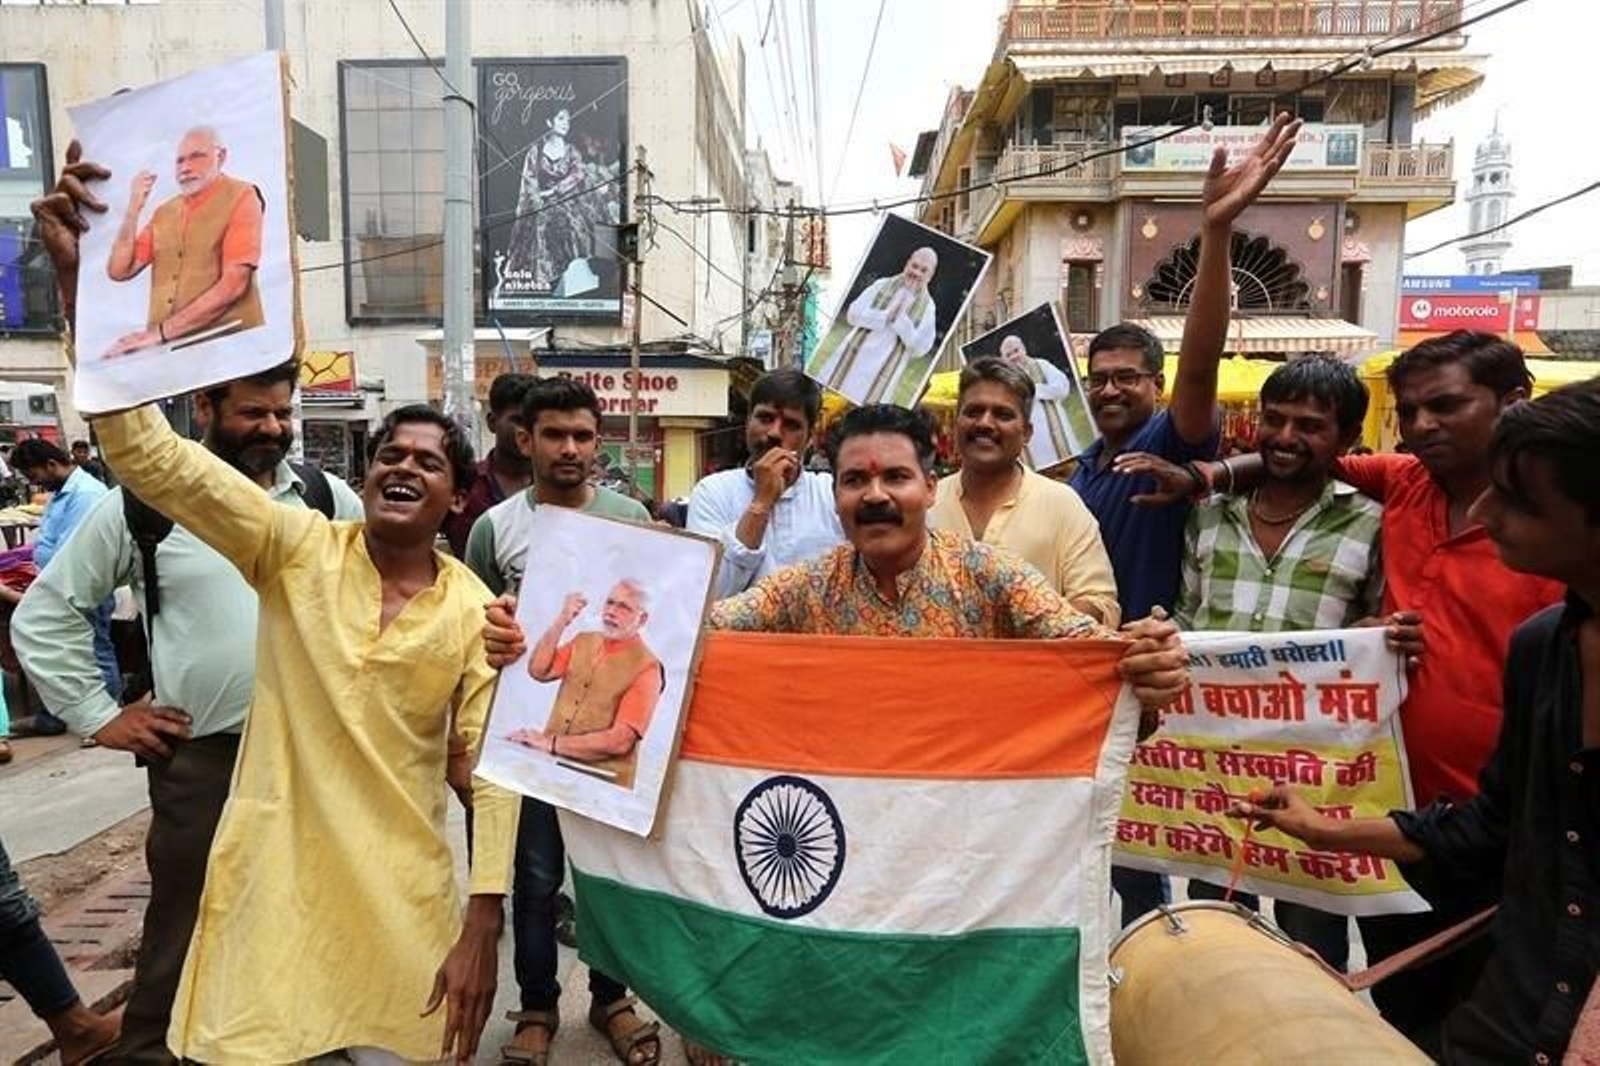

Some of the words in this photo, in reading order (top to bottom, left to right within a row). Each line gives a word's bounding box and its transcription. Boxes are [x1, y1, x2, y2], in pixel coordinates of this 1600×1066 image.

[493, 72, 518, 86] GO
[491, 83, 576, 125] gorgeous
[1402, 279, 1451, 288] AMSUNG
[1433, 304, 1499, 317] motorola
[622, 371, 678, 391] Shoe
[596, 397, 658, 412] orner
[1199, 670, 1307, 721] बचाओ
[1316, 670, 1380, 722] मंच
[1336, 752, 1377, 786] की
[1130, 780, 1186, 811] रक्षा
[1116, 819, 1159, 846] हम
[1242, 841, 1290, 873] हम
